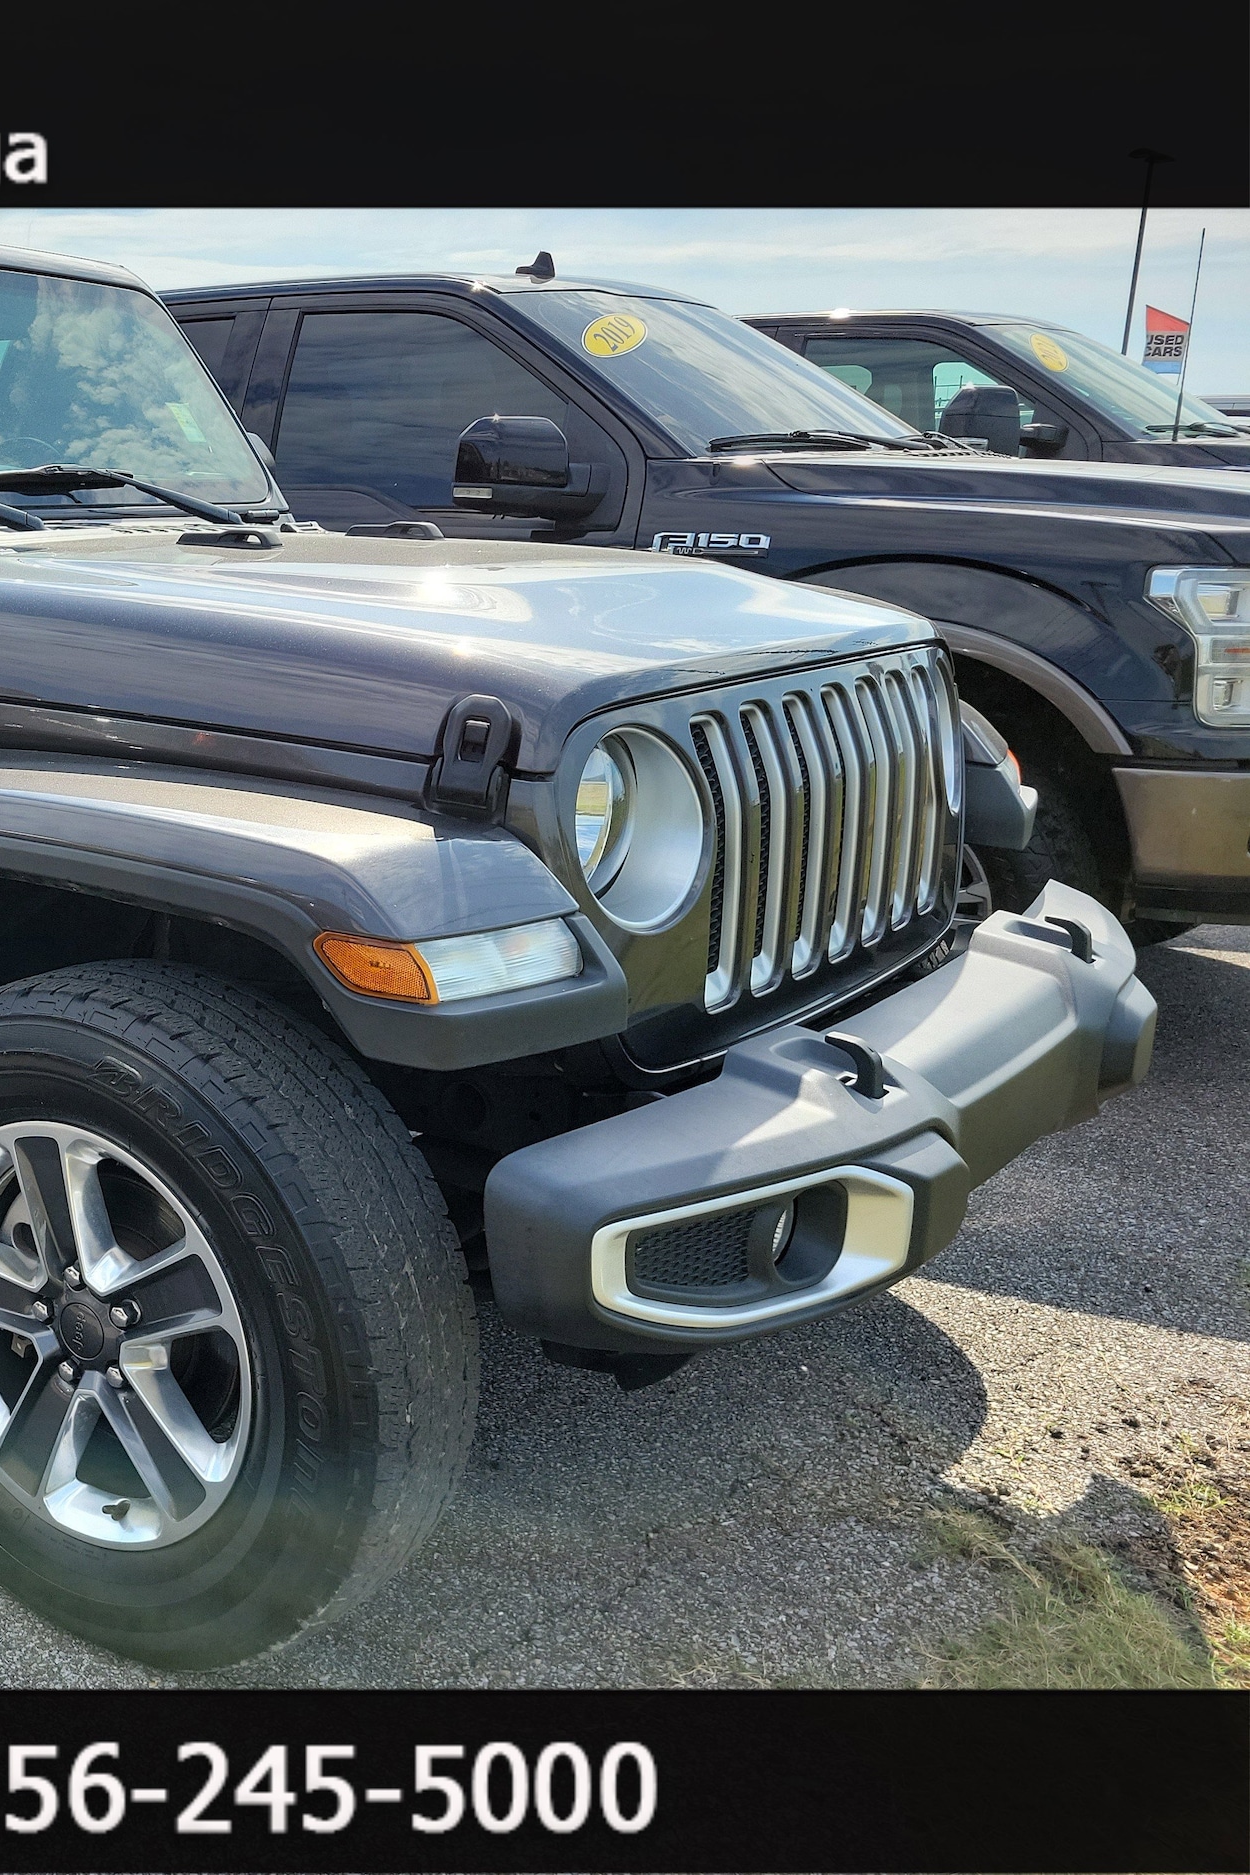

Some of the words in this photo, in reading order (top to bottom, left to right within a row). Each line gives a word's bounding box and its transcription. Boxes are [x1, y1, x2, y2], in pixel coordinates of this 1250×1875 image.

[593, 316, 636, 353] 2019
[86, 1056, 327, 1522] BRIDGESTONE
[71, 1311, 87, 1347] Jeep
